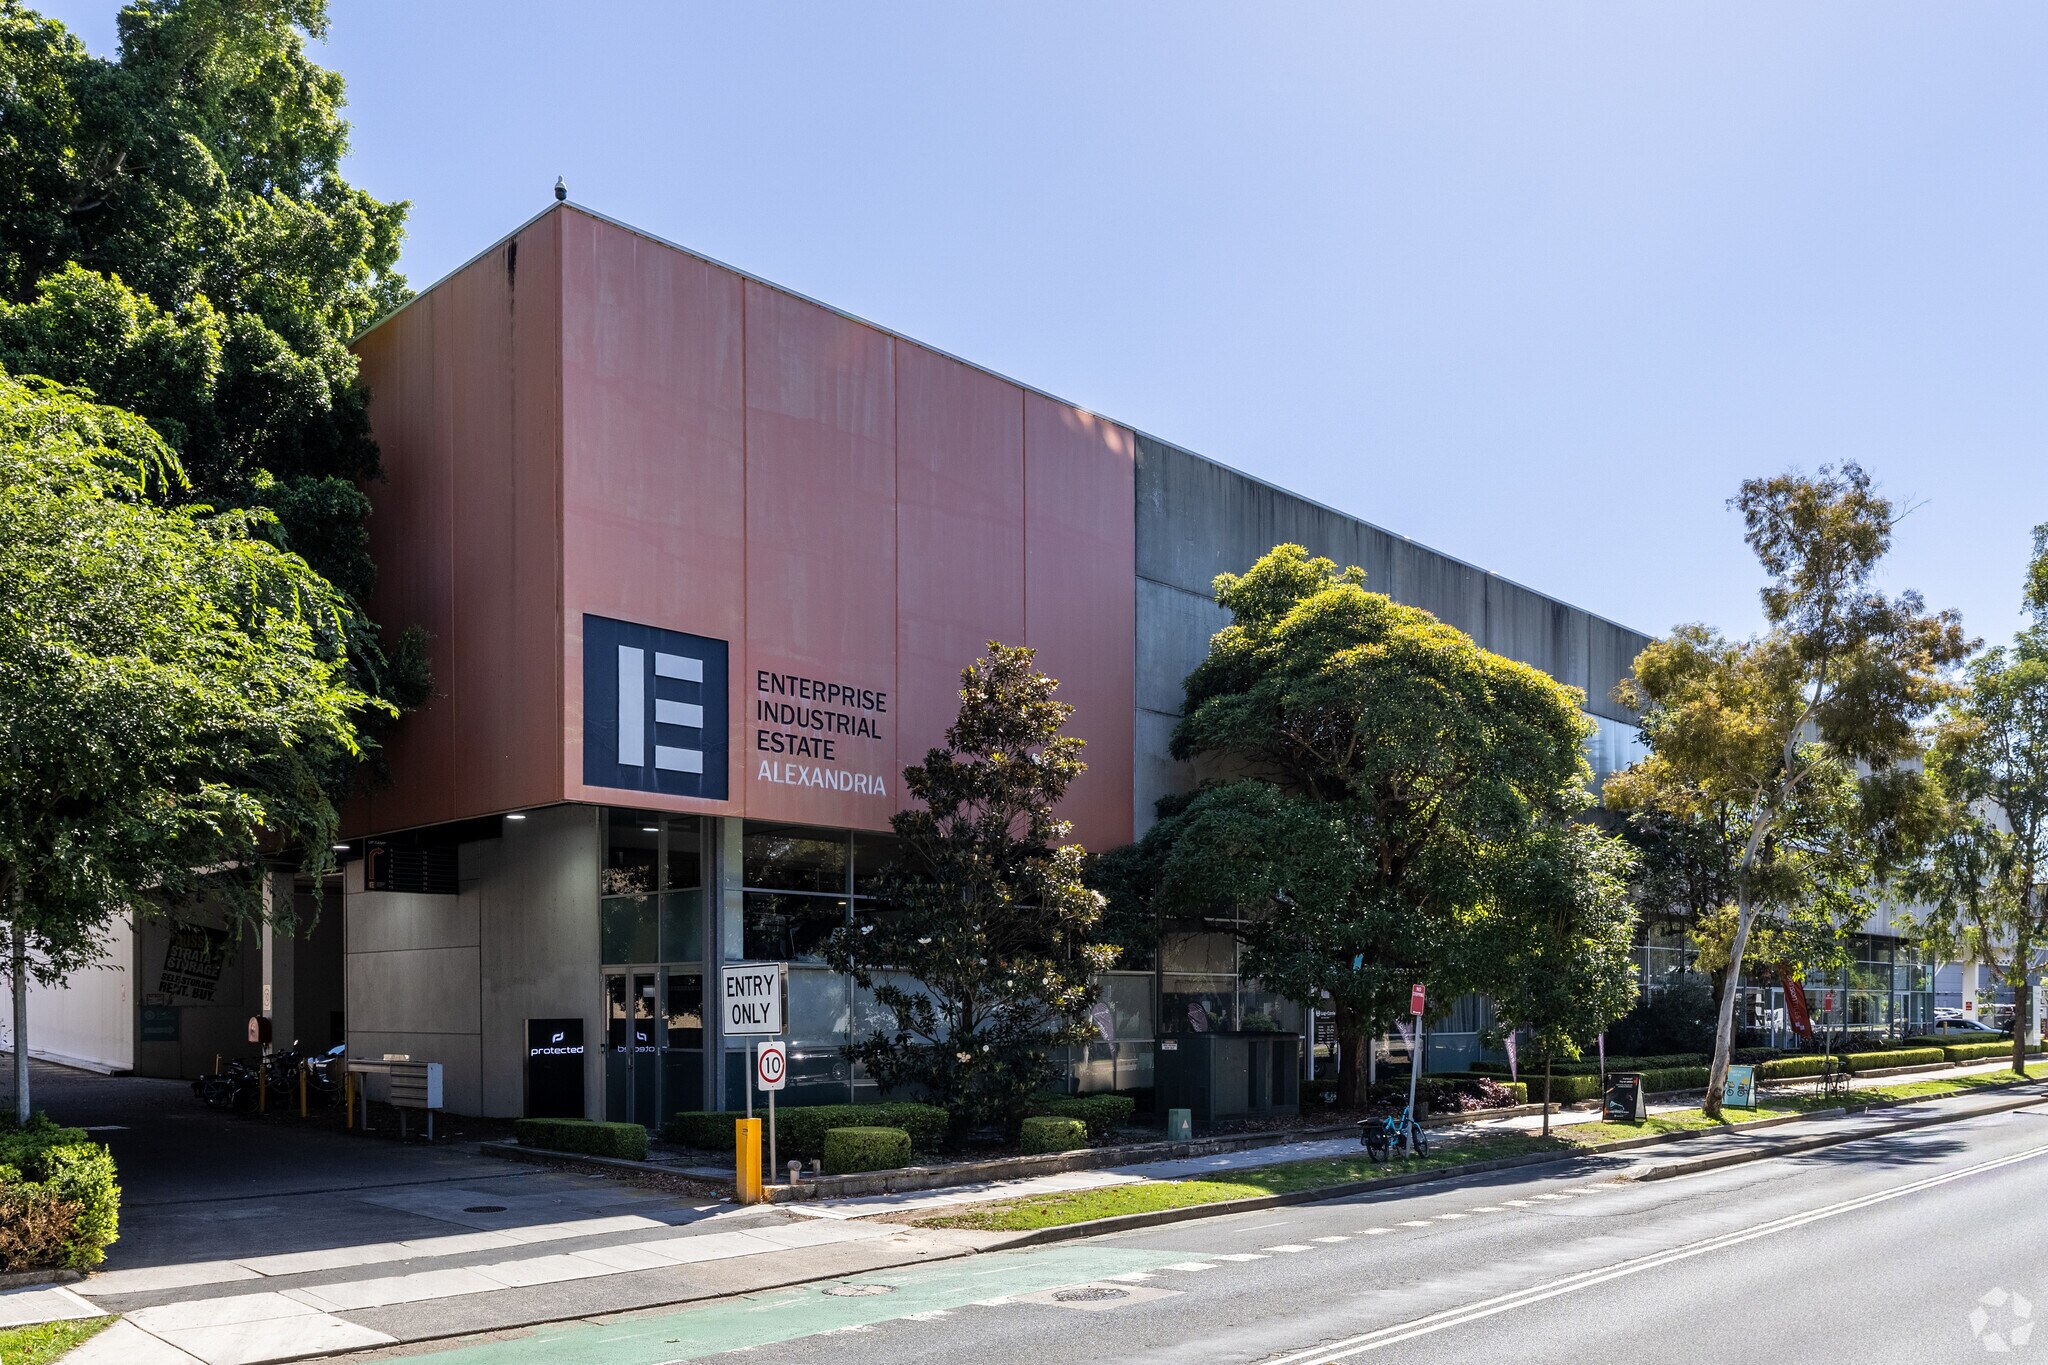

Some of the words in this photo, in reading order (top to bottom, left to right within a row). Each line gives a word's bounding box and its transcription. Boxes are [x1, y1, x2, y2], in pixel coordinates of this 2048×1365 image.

[758, 670, 887, 713] ENTERPRISE
[758, 699, 882, 740] INDUSTRIAL
[757, 730, 835, 761] ESTATE
[757, 759, 887, 797] ALEXANDRIA
[160, 972, 181, 984] SELF
[727, 974, 775, 998] ENTRY
[191, 988, 215, 1002] BUY.
[732, 1002, 771, 1025] ONLY
[531, 1045, 584, 1057] protected
[765, 1056, 781, 1074] 10
